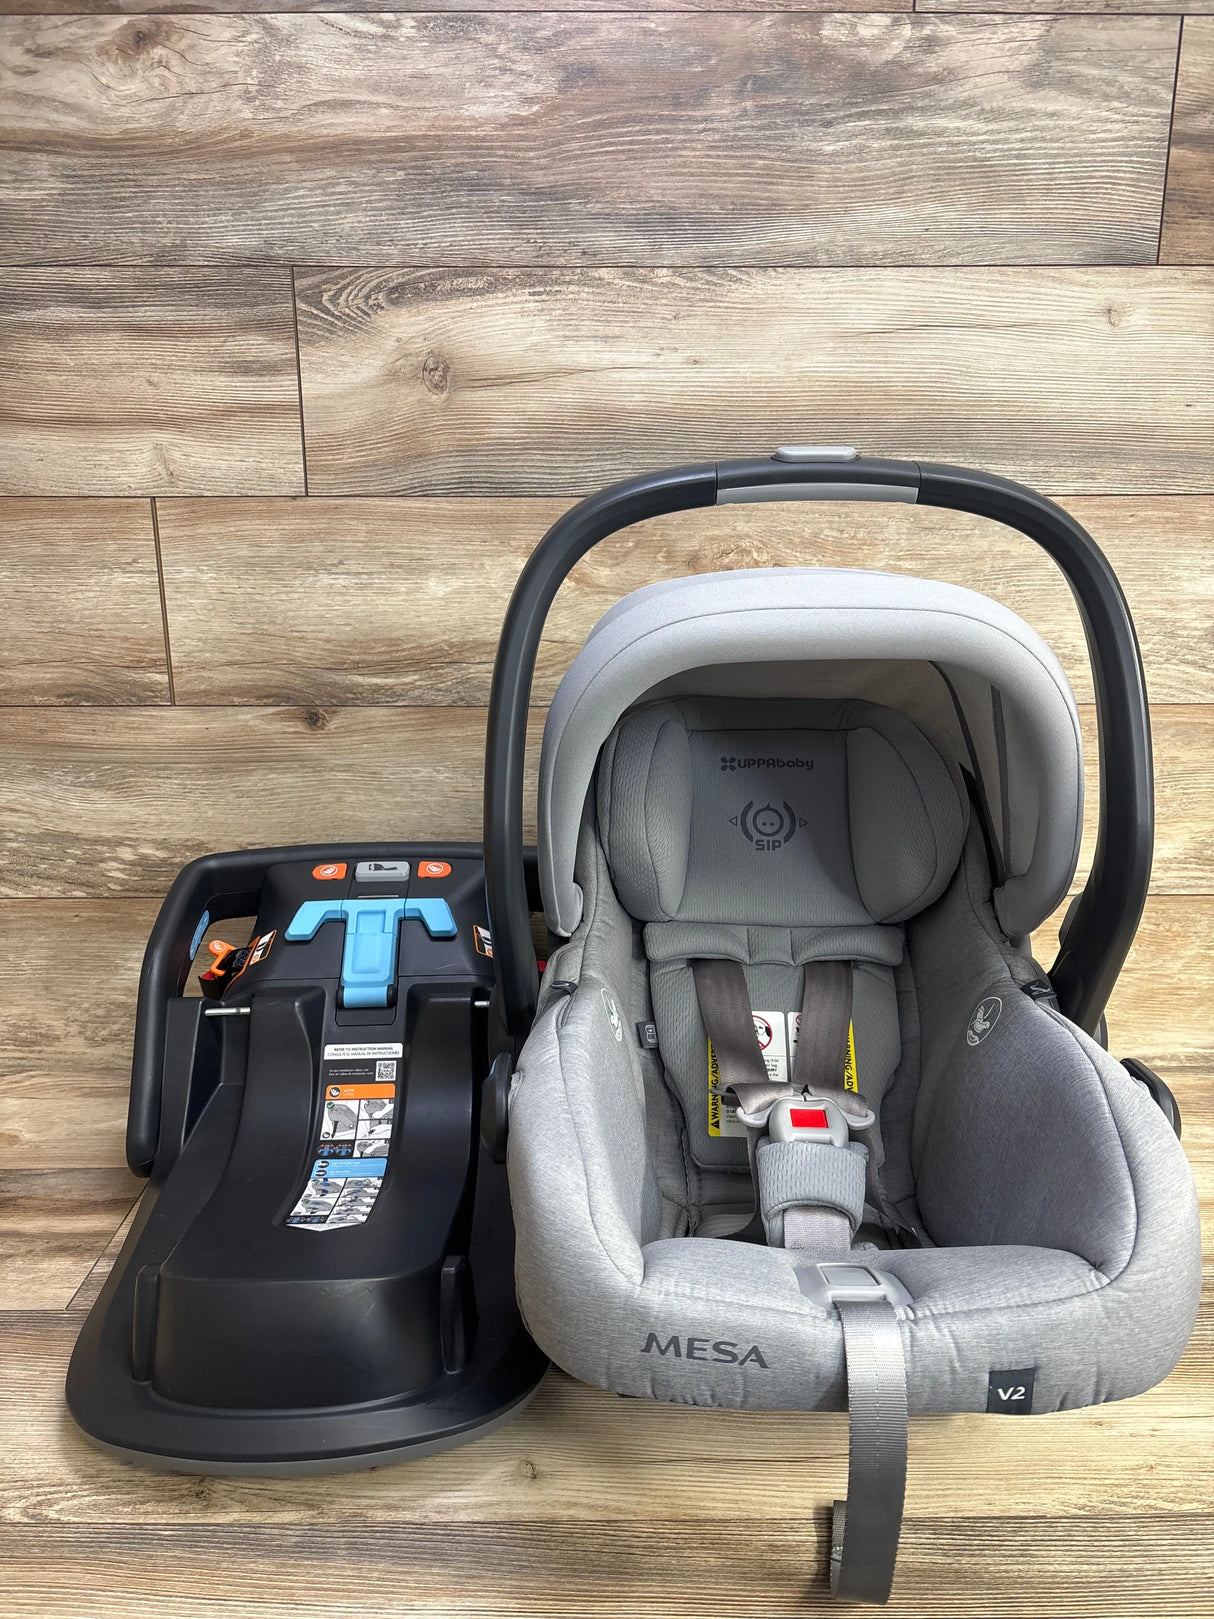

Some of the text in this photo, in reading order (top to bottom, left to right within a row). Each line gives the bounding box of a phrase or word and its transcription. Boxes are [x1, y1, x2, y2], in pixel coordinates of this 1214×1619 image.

[737, 757, 815, 771] UPPAbaby
[755, 839, 782, 852] SIP
[640, 1333, 769, 1368] MESA
[996, 1385, 1027, 1401] V2
